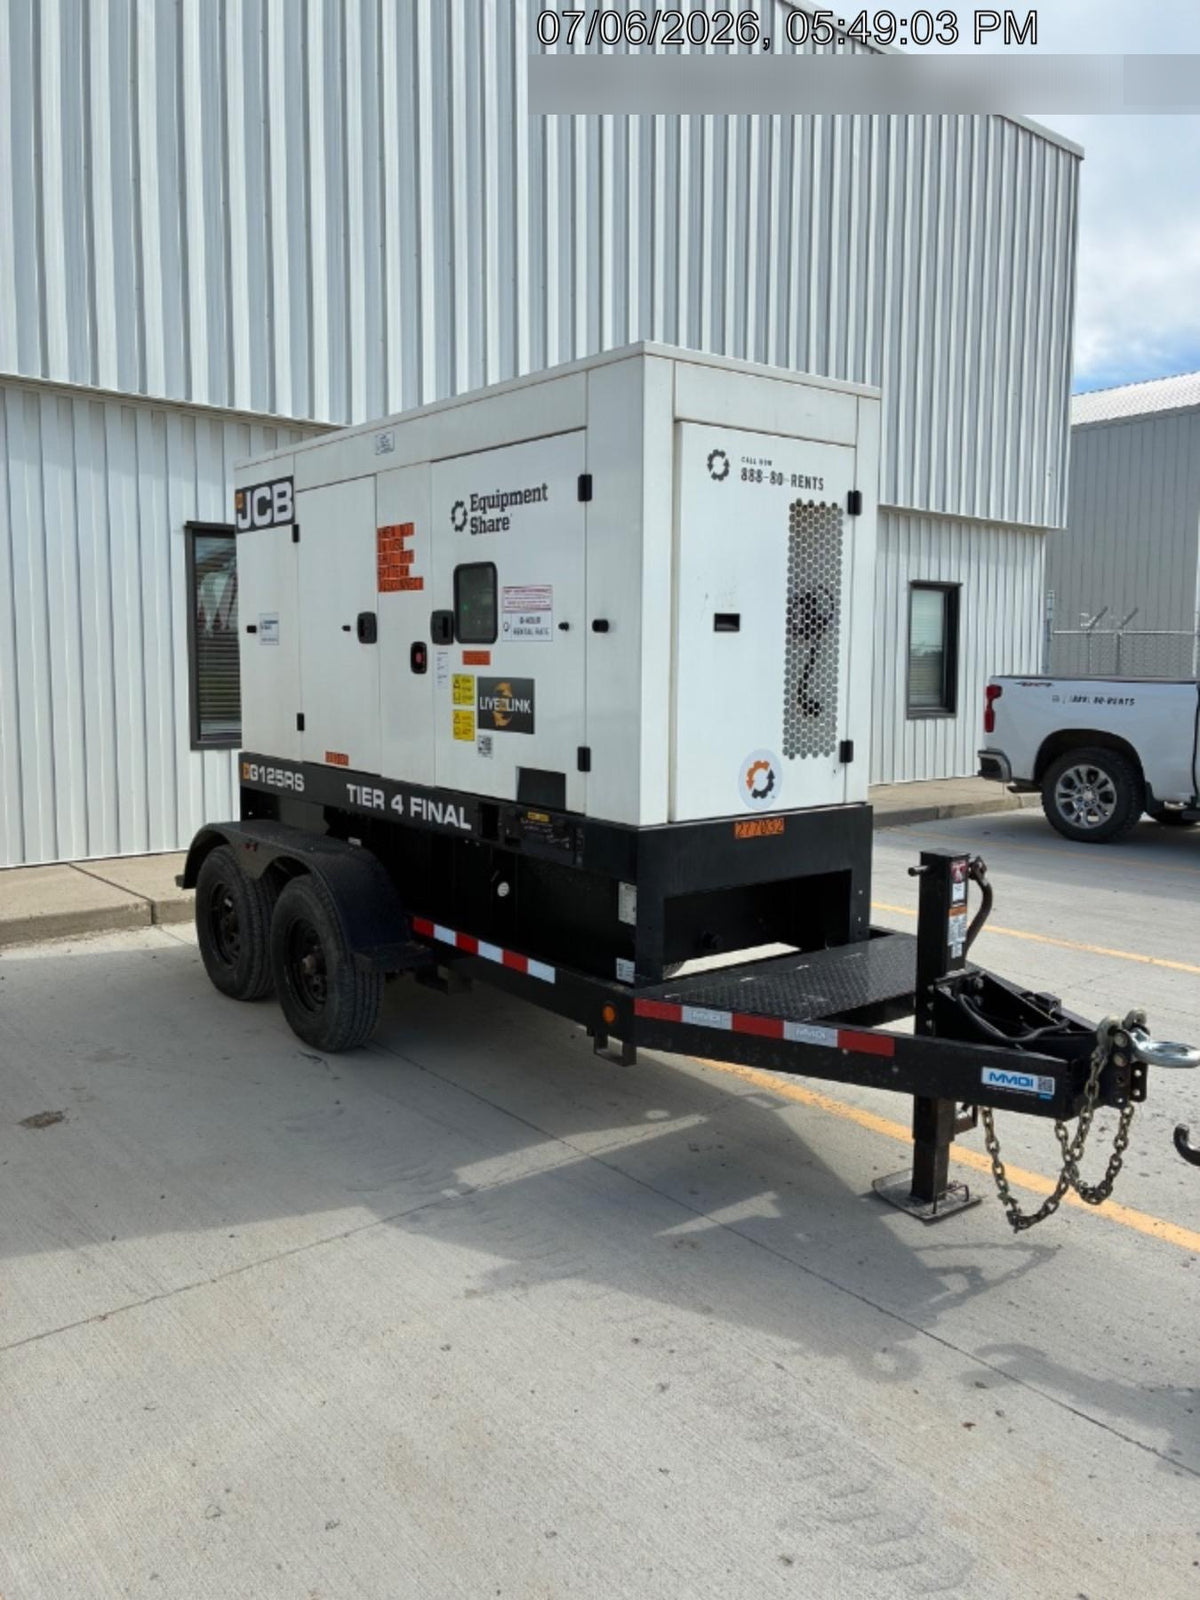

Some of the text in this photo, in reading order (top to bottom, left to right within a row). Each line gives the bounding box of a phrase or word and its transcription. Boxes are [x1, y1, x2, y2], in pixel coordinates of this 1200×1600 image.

[237, 481, 293, 529] JCB
[469, 482, 548, 514] Equipment
[470, 515, 510, 535] Share
[346, 783, 472, 831] TIER 4 FINAL
[988, 1072, 1035, 1088] MMDI
